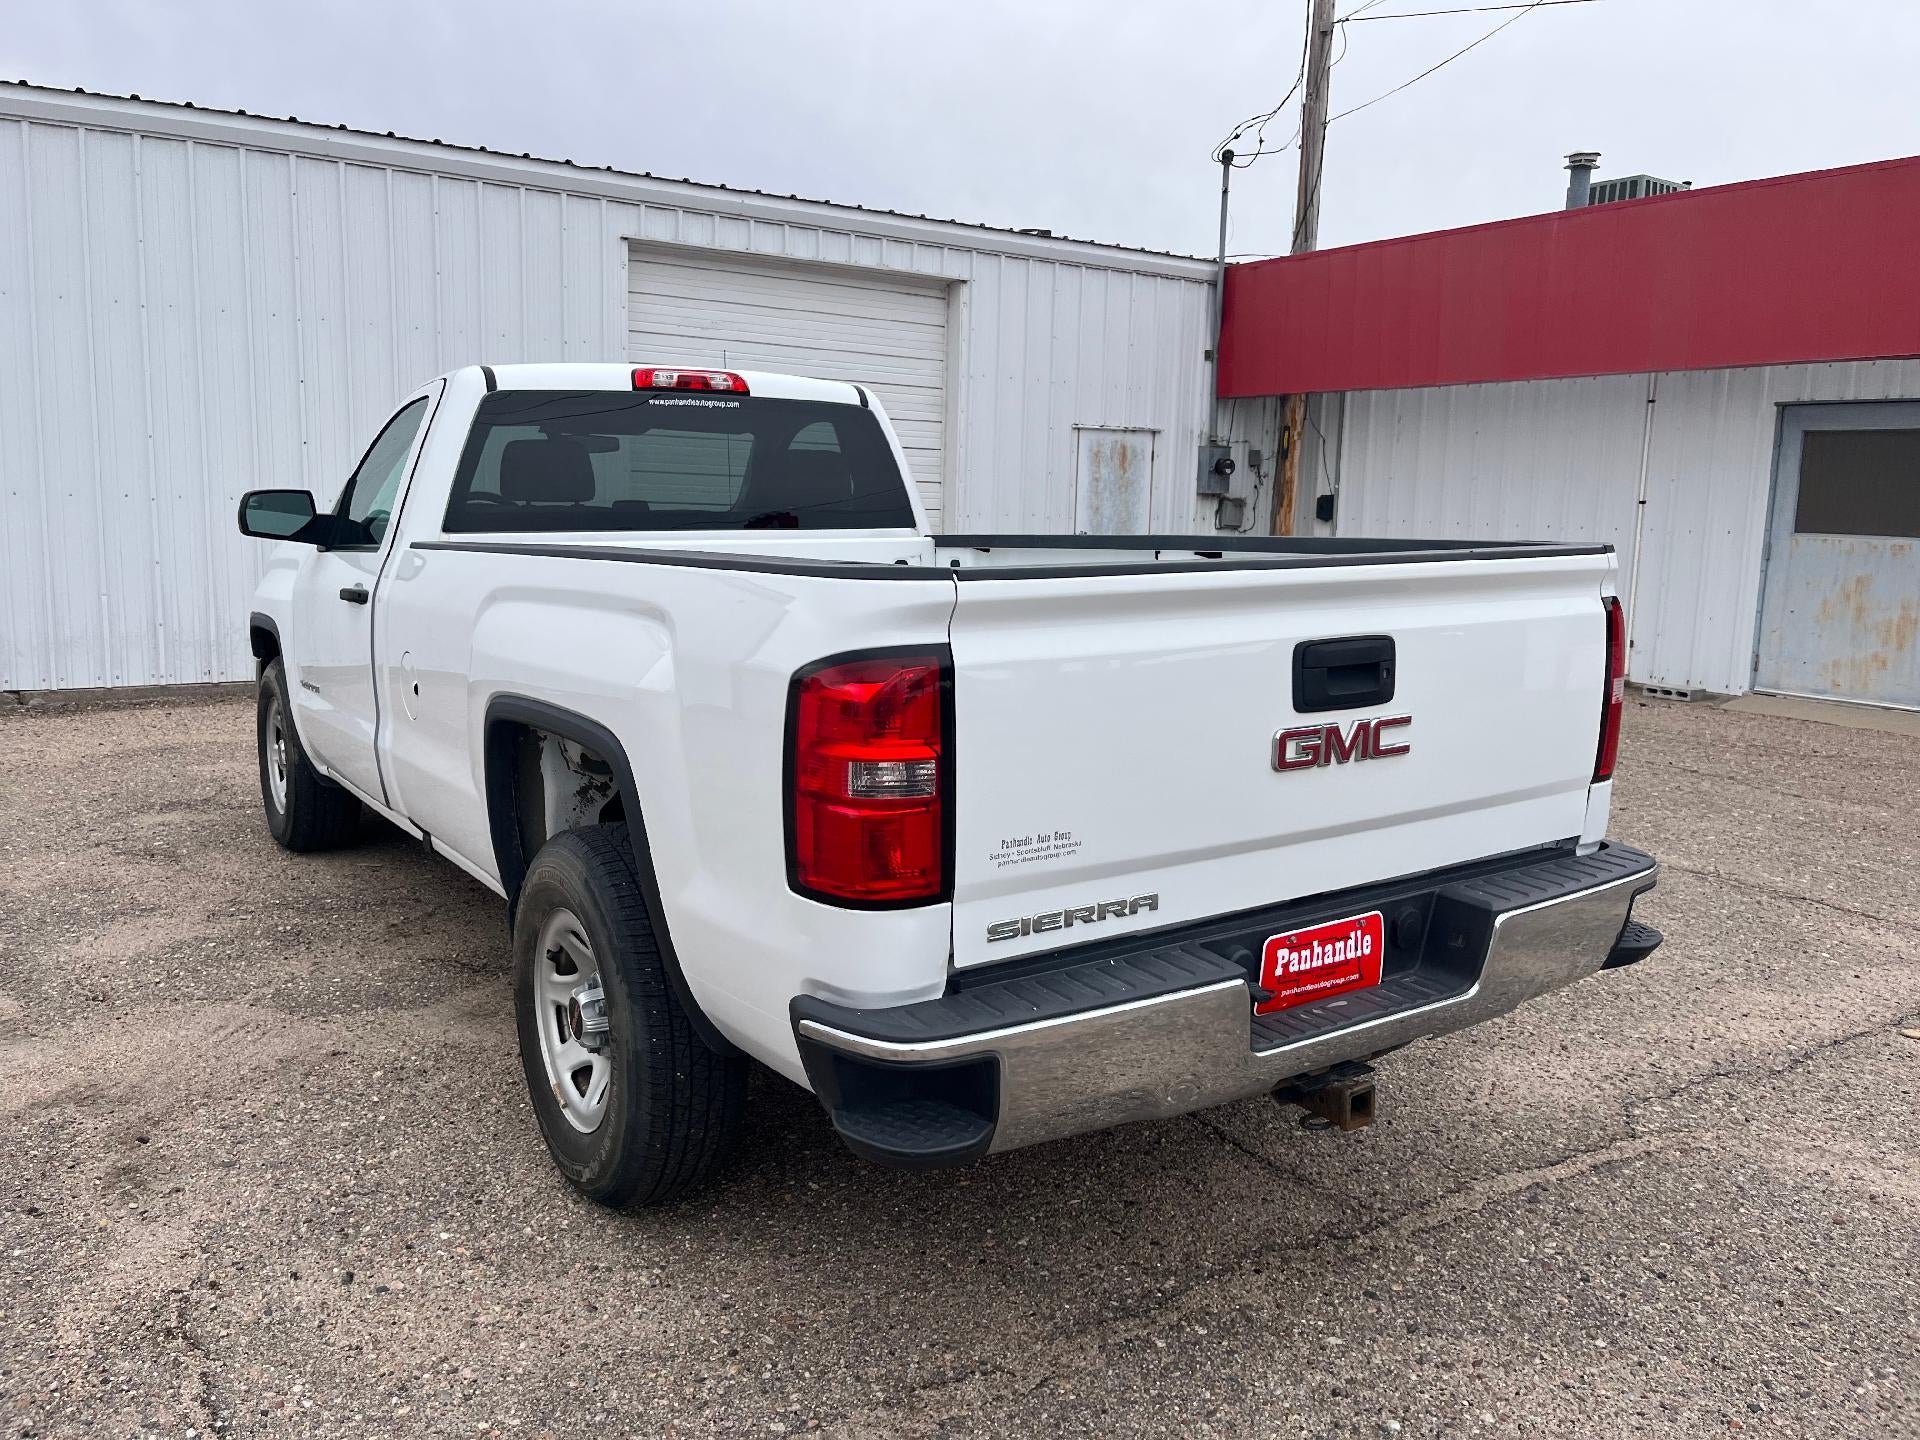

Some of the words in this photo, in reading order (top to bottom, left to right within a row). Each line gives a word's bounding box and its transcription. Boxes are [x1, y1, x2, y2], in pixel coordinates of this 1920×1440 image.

[648, 398, 740, 409] www.panhandleautogroup.com
[1271, 712, 1413, 772] GMC
[1001, 836, 1033, 849] Panhandle
[1036, 833, 1051, 844] Auto
[1054, 831, 1072, 841] Group
[986, 892, 1159, 943] SIERRA
[1274, 930, 1372, 977] Panhandle
[1280, 973, 1360, 998] panhandleautogroup.com
